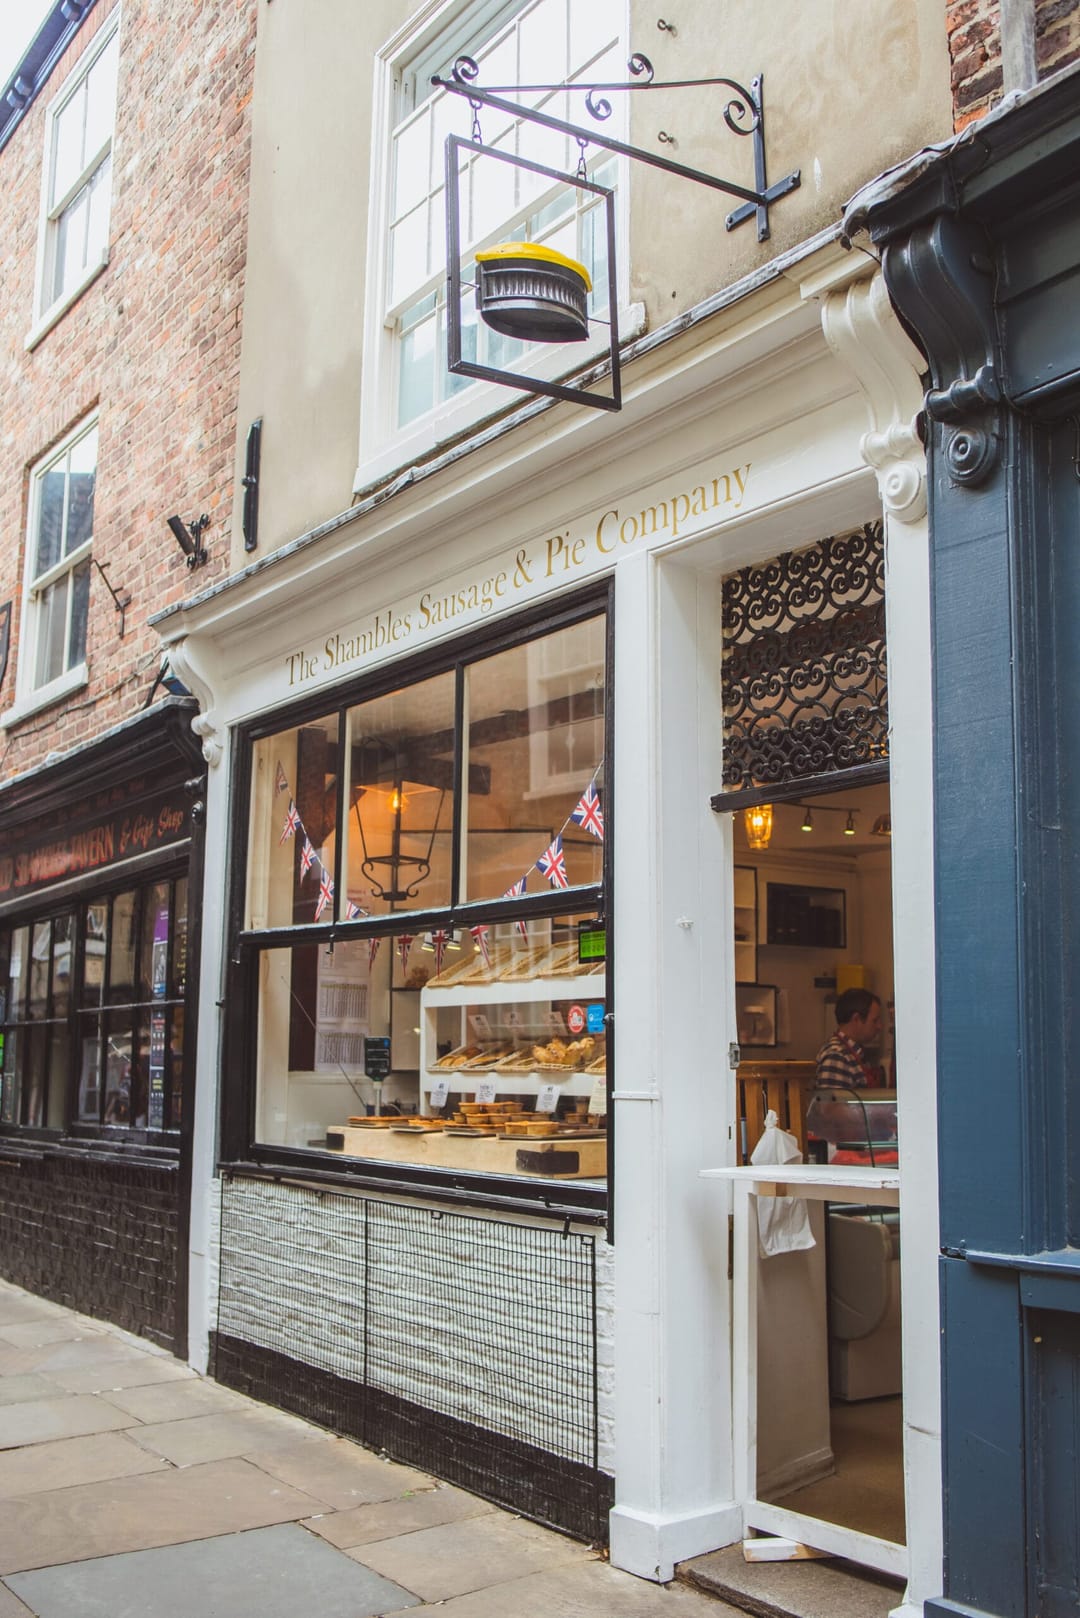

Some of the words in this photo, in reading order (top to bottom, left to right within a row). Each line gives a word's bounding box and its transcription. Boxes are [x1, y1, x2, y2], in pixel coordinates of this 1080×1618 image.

[285, 650, 319, 686] The
[323, 610, 412, 671] Shambles
[418, 571, 507, 630] Sausage
[512, 549, 534, 589] &
[543, 530, 586, 579] Pie
[595, 463, 752, 554] Company
[70, 824, 114, 871] TAVERN
